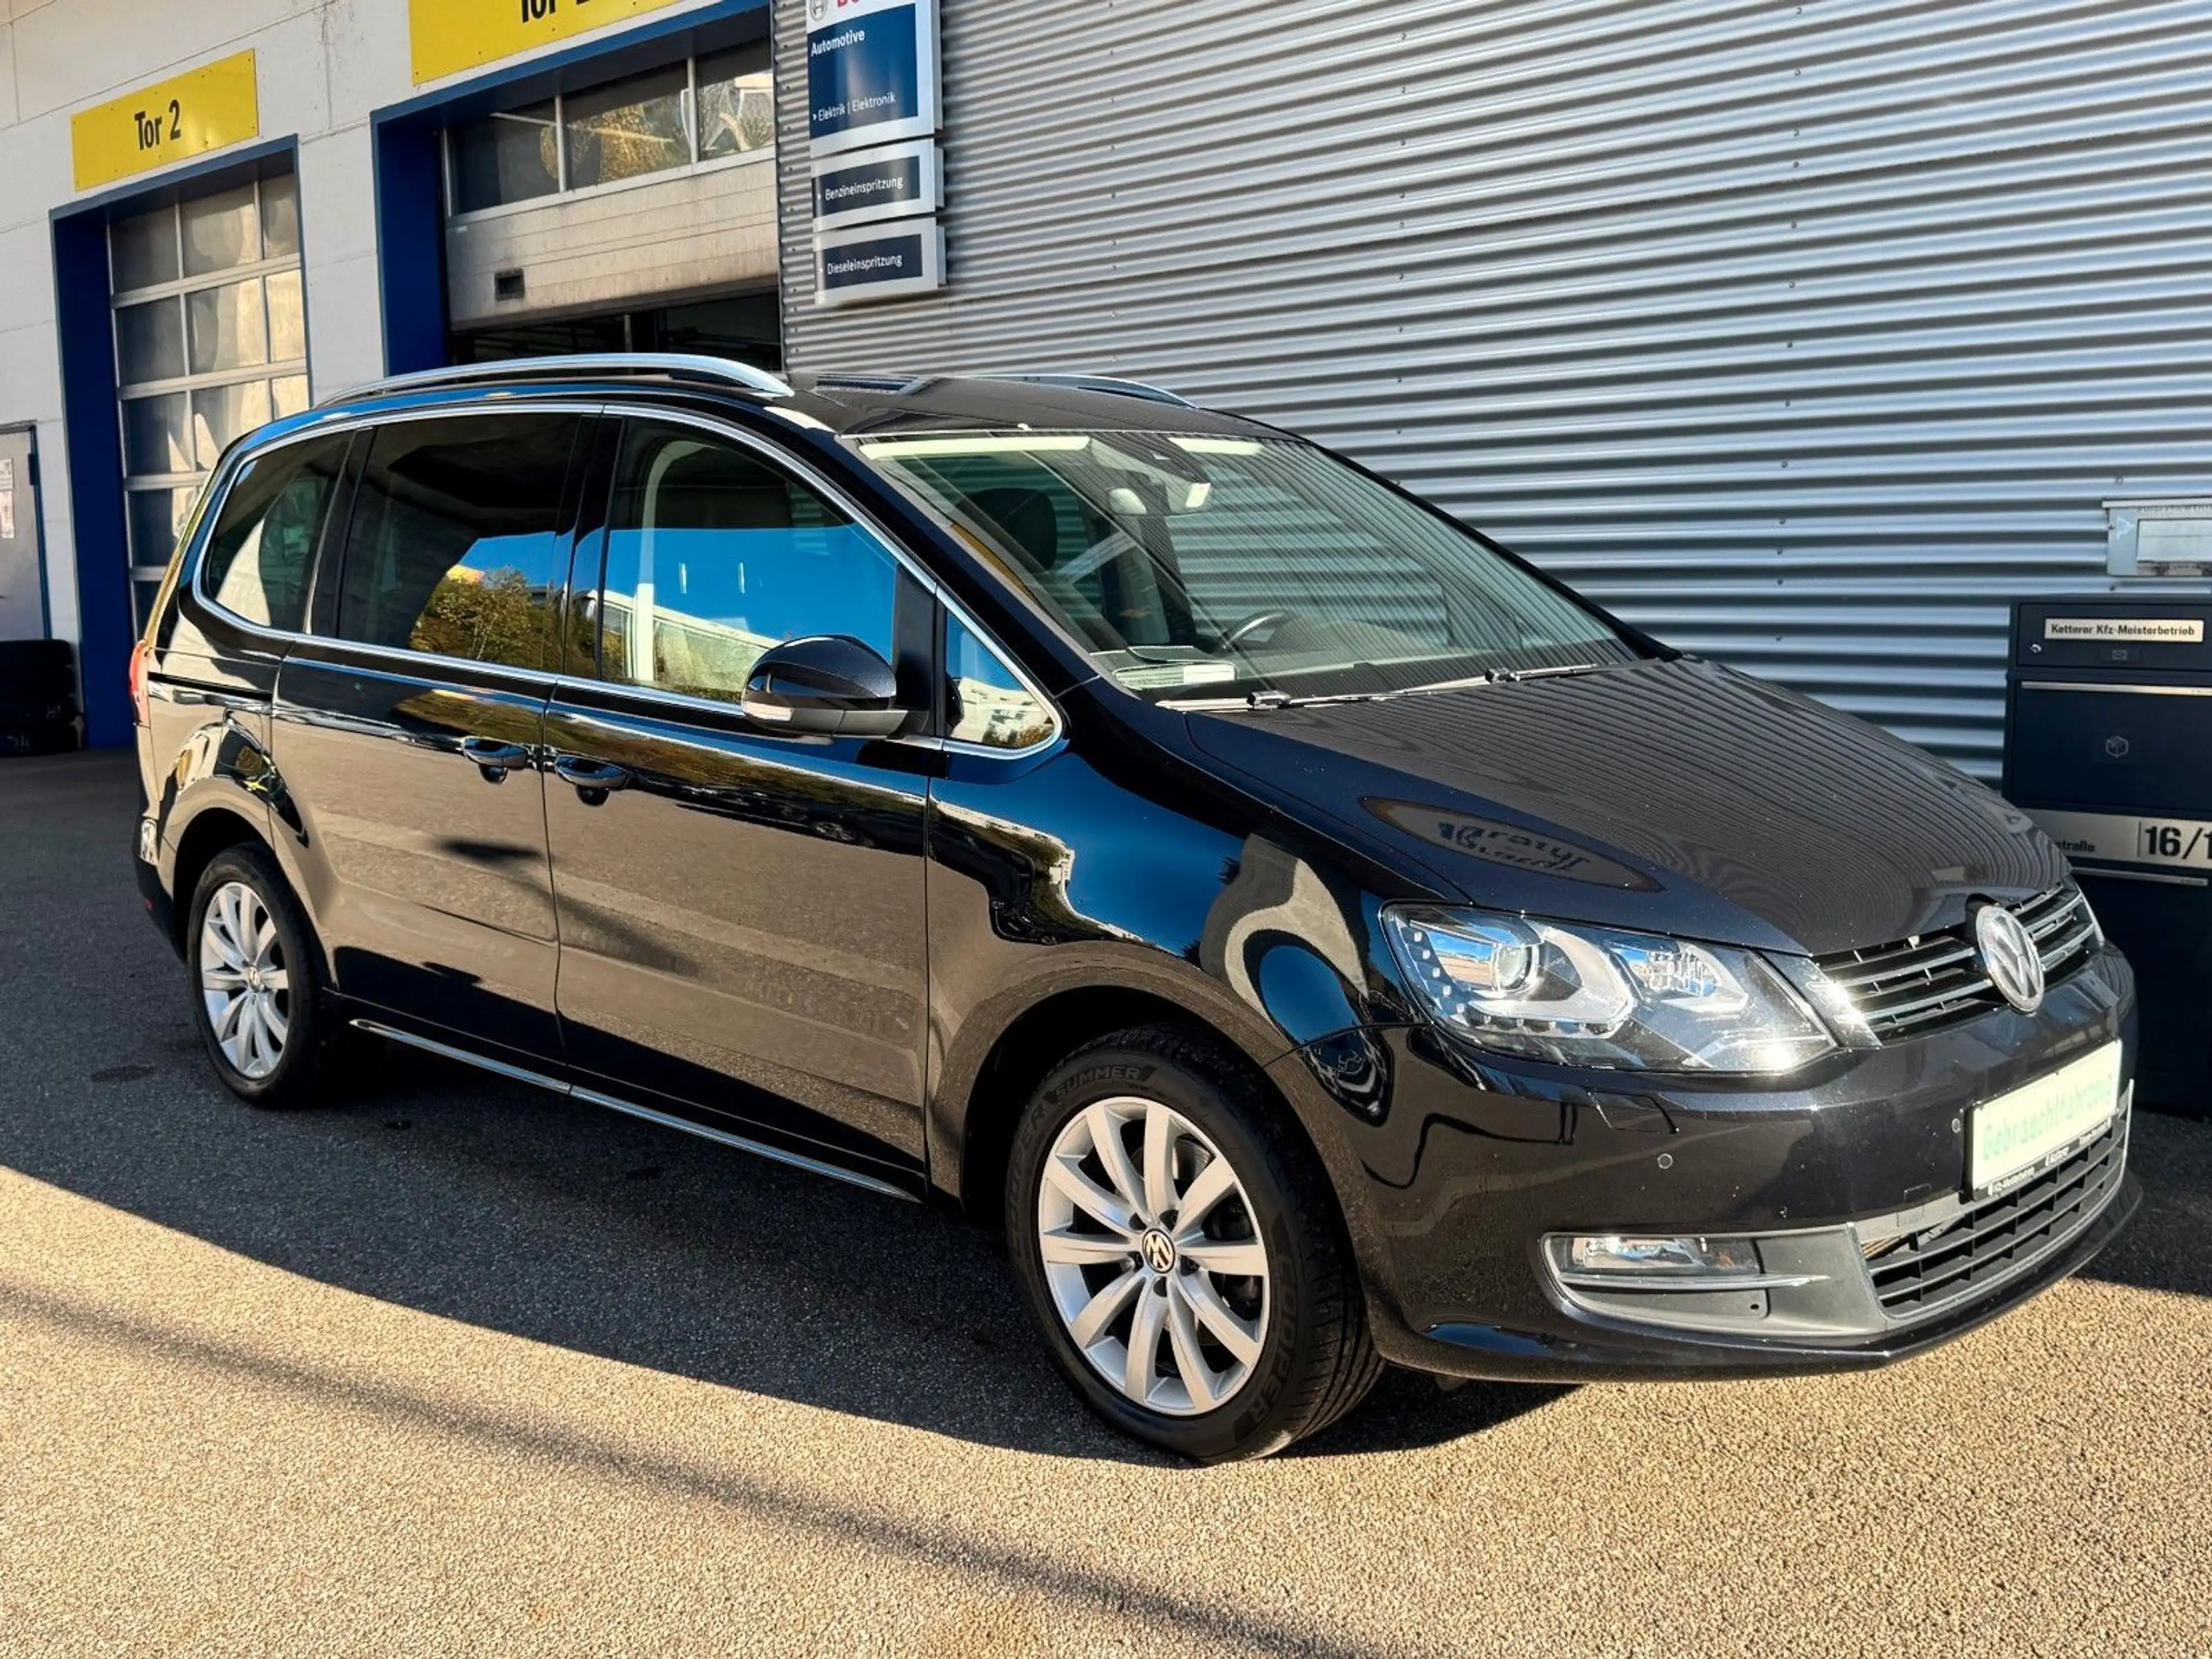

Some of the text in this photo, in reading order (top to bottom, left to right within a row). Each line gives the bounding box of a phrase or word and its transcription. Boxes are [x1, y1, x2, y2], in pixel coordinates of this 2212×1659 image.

[811, 29, 865, 57] Automotive
[818, 103, 846, 121] Elektrik
[852, 92, 896, 112] Elektronik
[134, 99, 181, 150] Tor 2
[825, 176, 904, 201] Benzineinspritzung
[827, 254, 903, 275] Dieseleinspritzung
[2051, 623, 2195, 636] Ketterer Kfz-Meisterbetrieb
[1055, 1065, 1141, 1096] SUMMER
